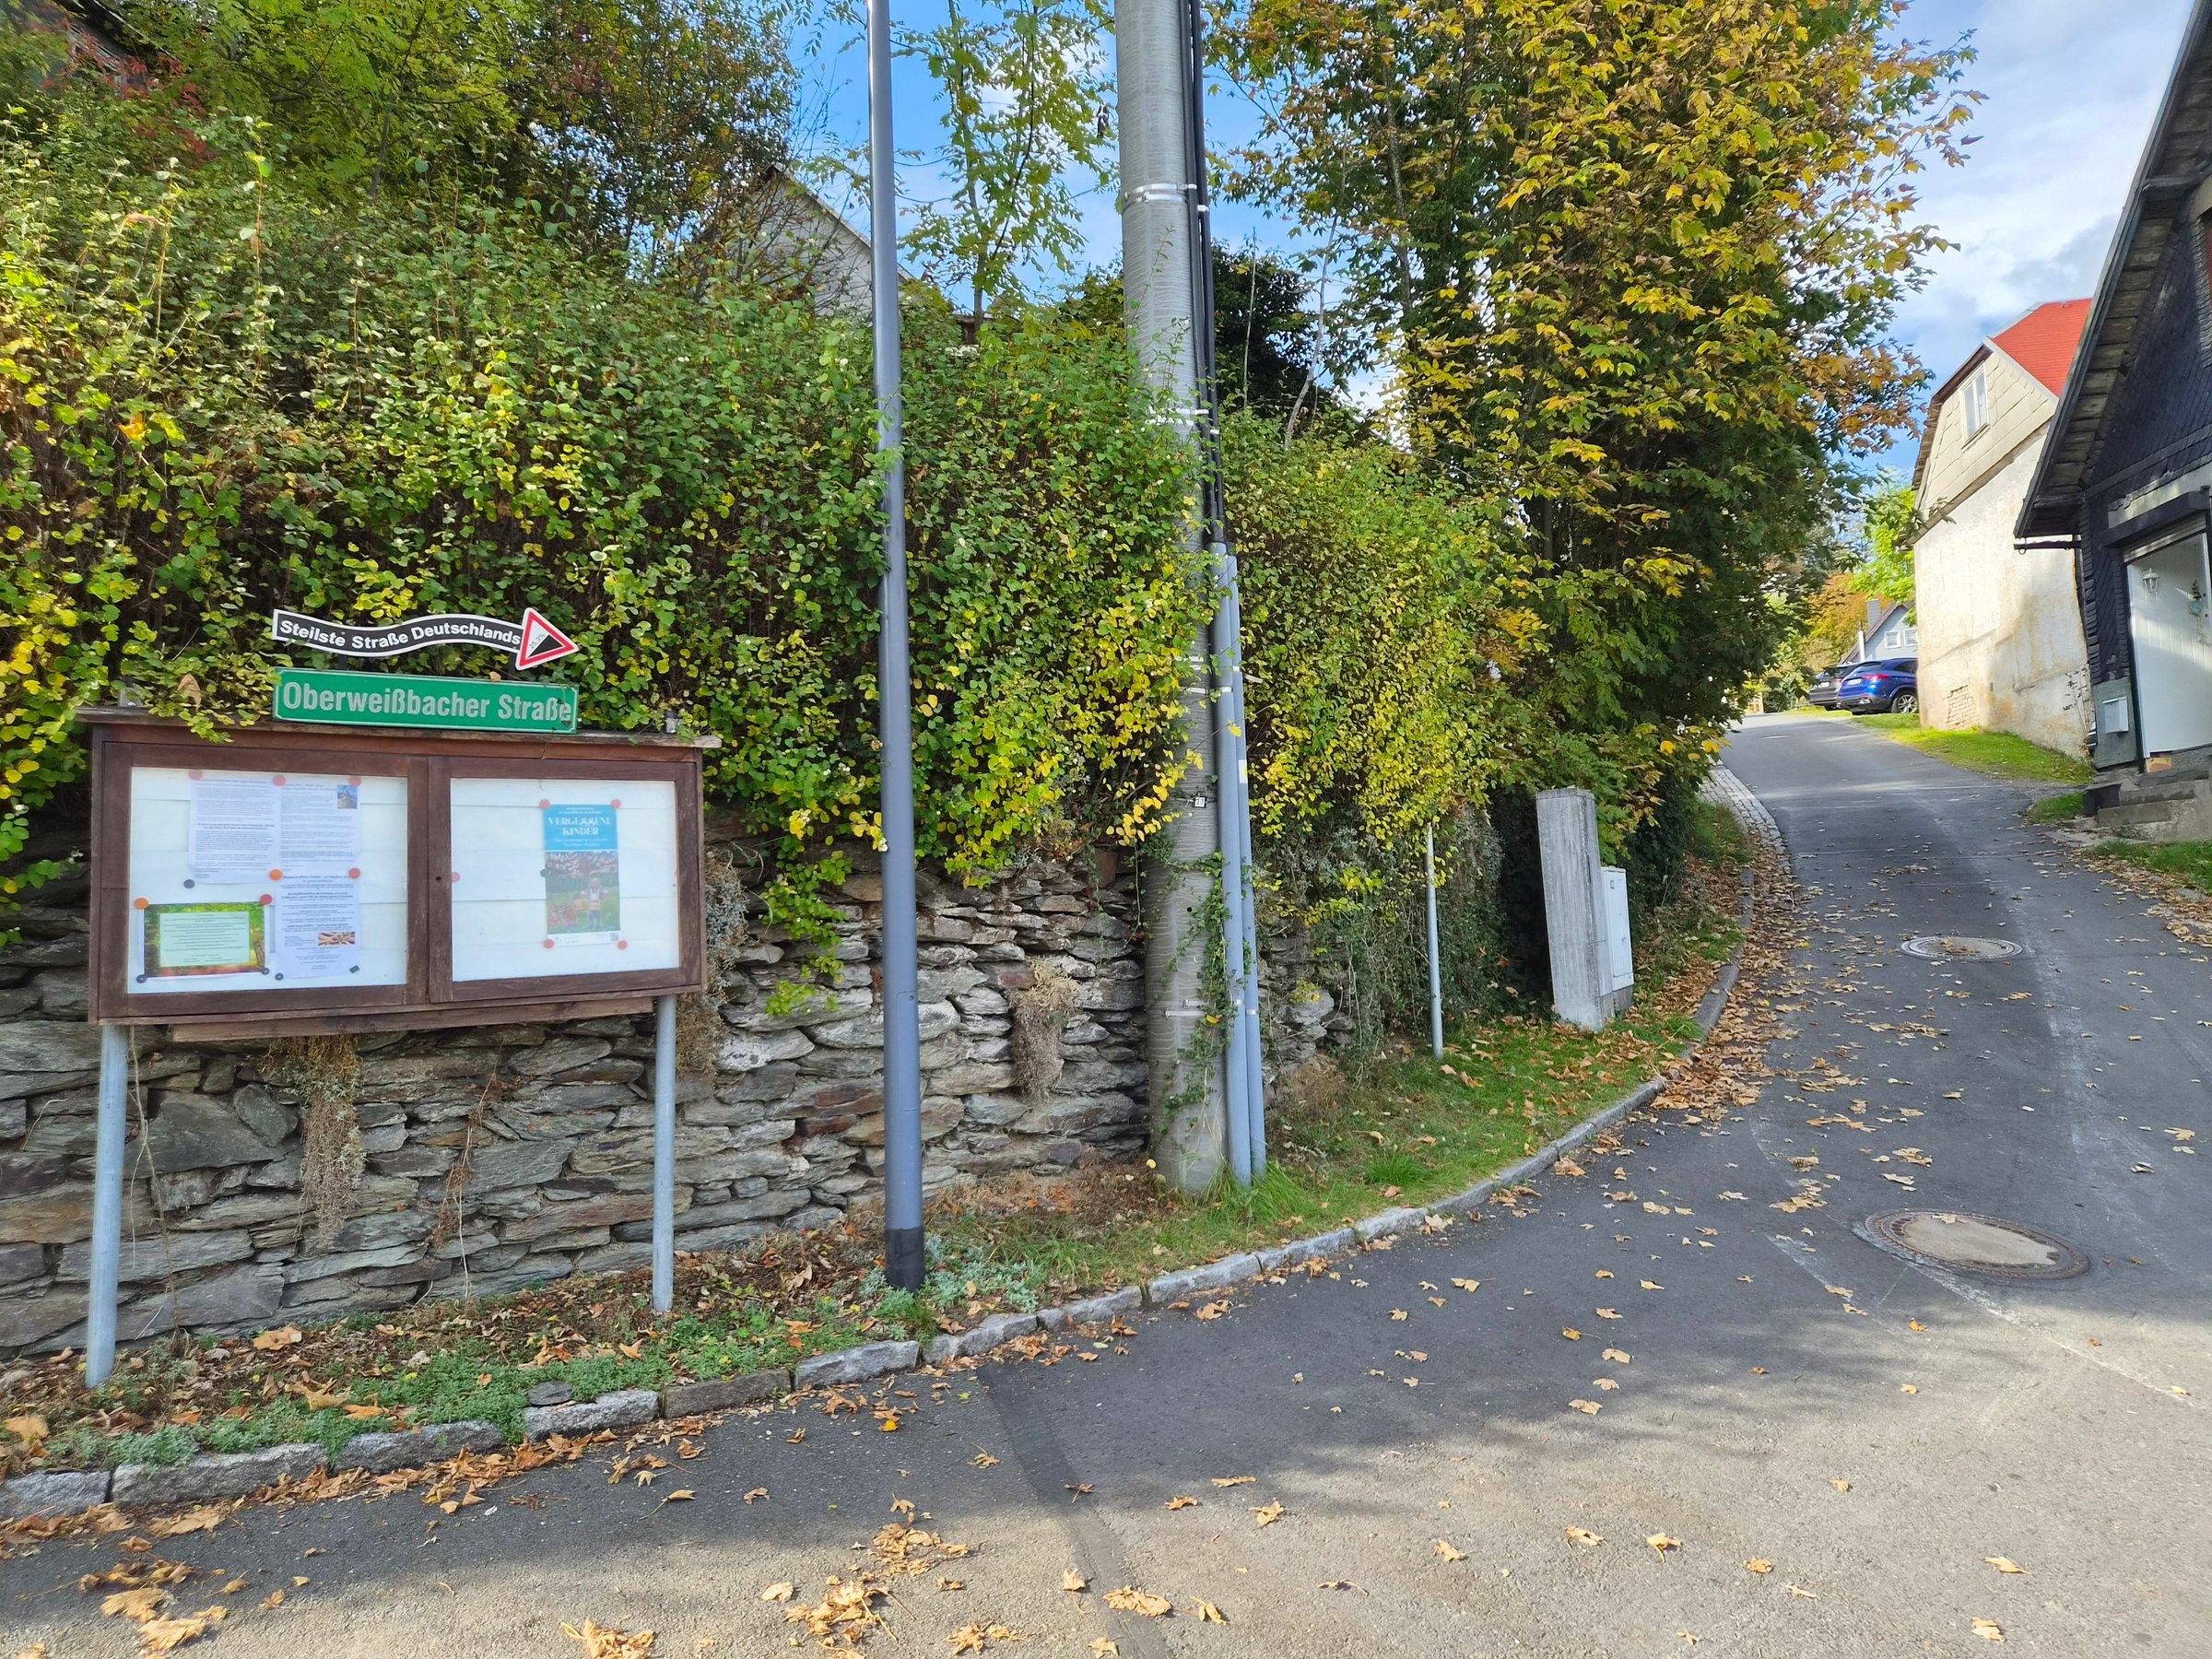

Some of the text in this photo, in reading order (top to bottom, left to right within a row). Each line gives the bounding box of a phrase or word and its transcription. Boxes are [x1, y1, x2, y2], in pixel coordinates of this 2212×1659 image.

[280, 620, 521, 649] Steilste Straße Deutschlands
[284, 681, 571, 721] Oberweißbacher Straße
[562, 827, 600, 836] KINDER
